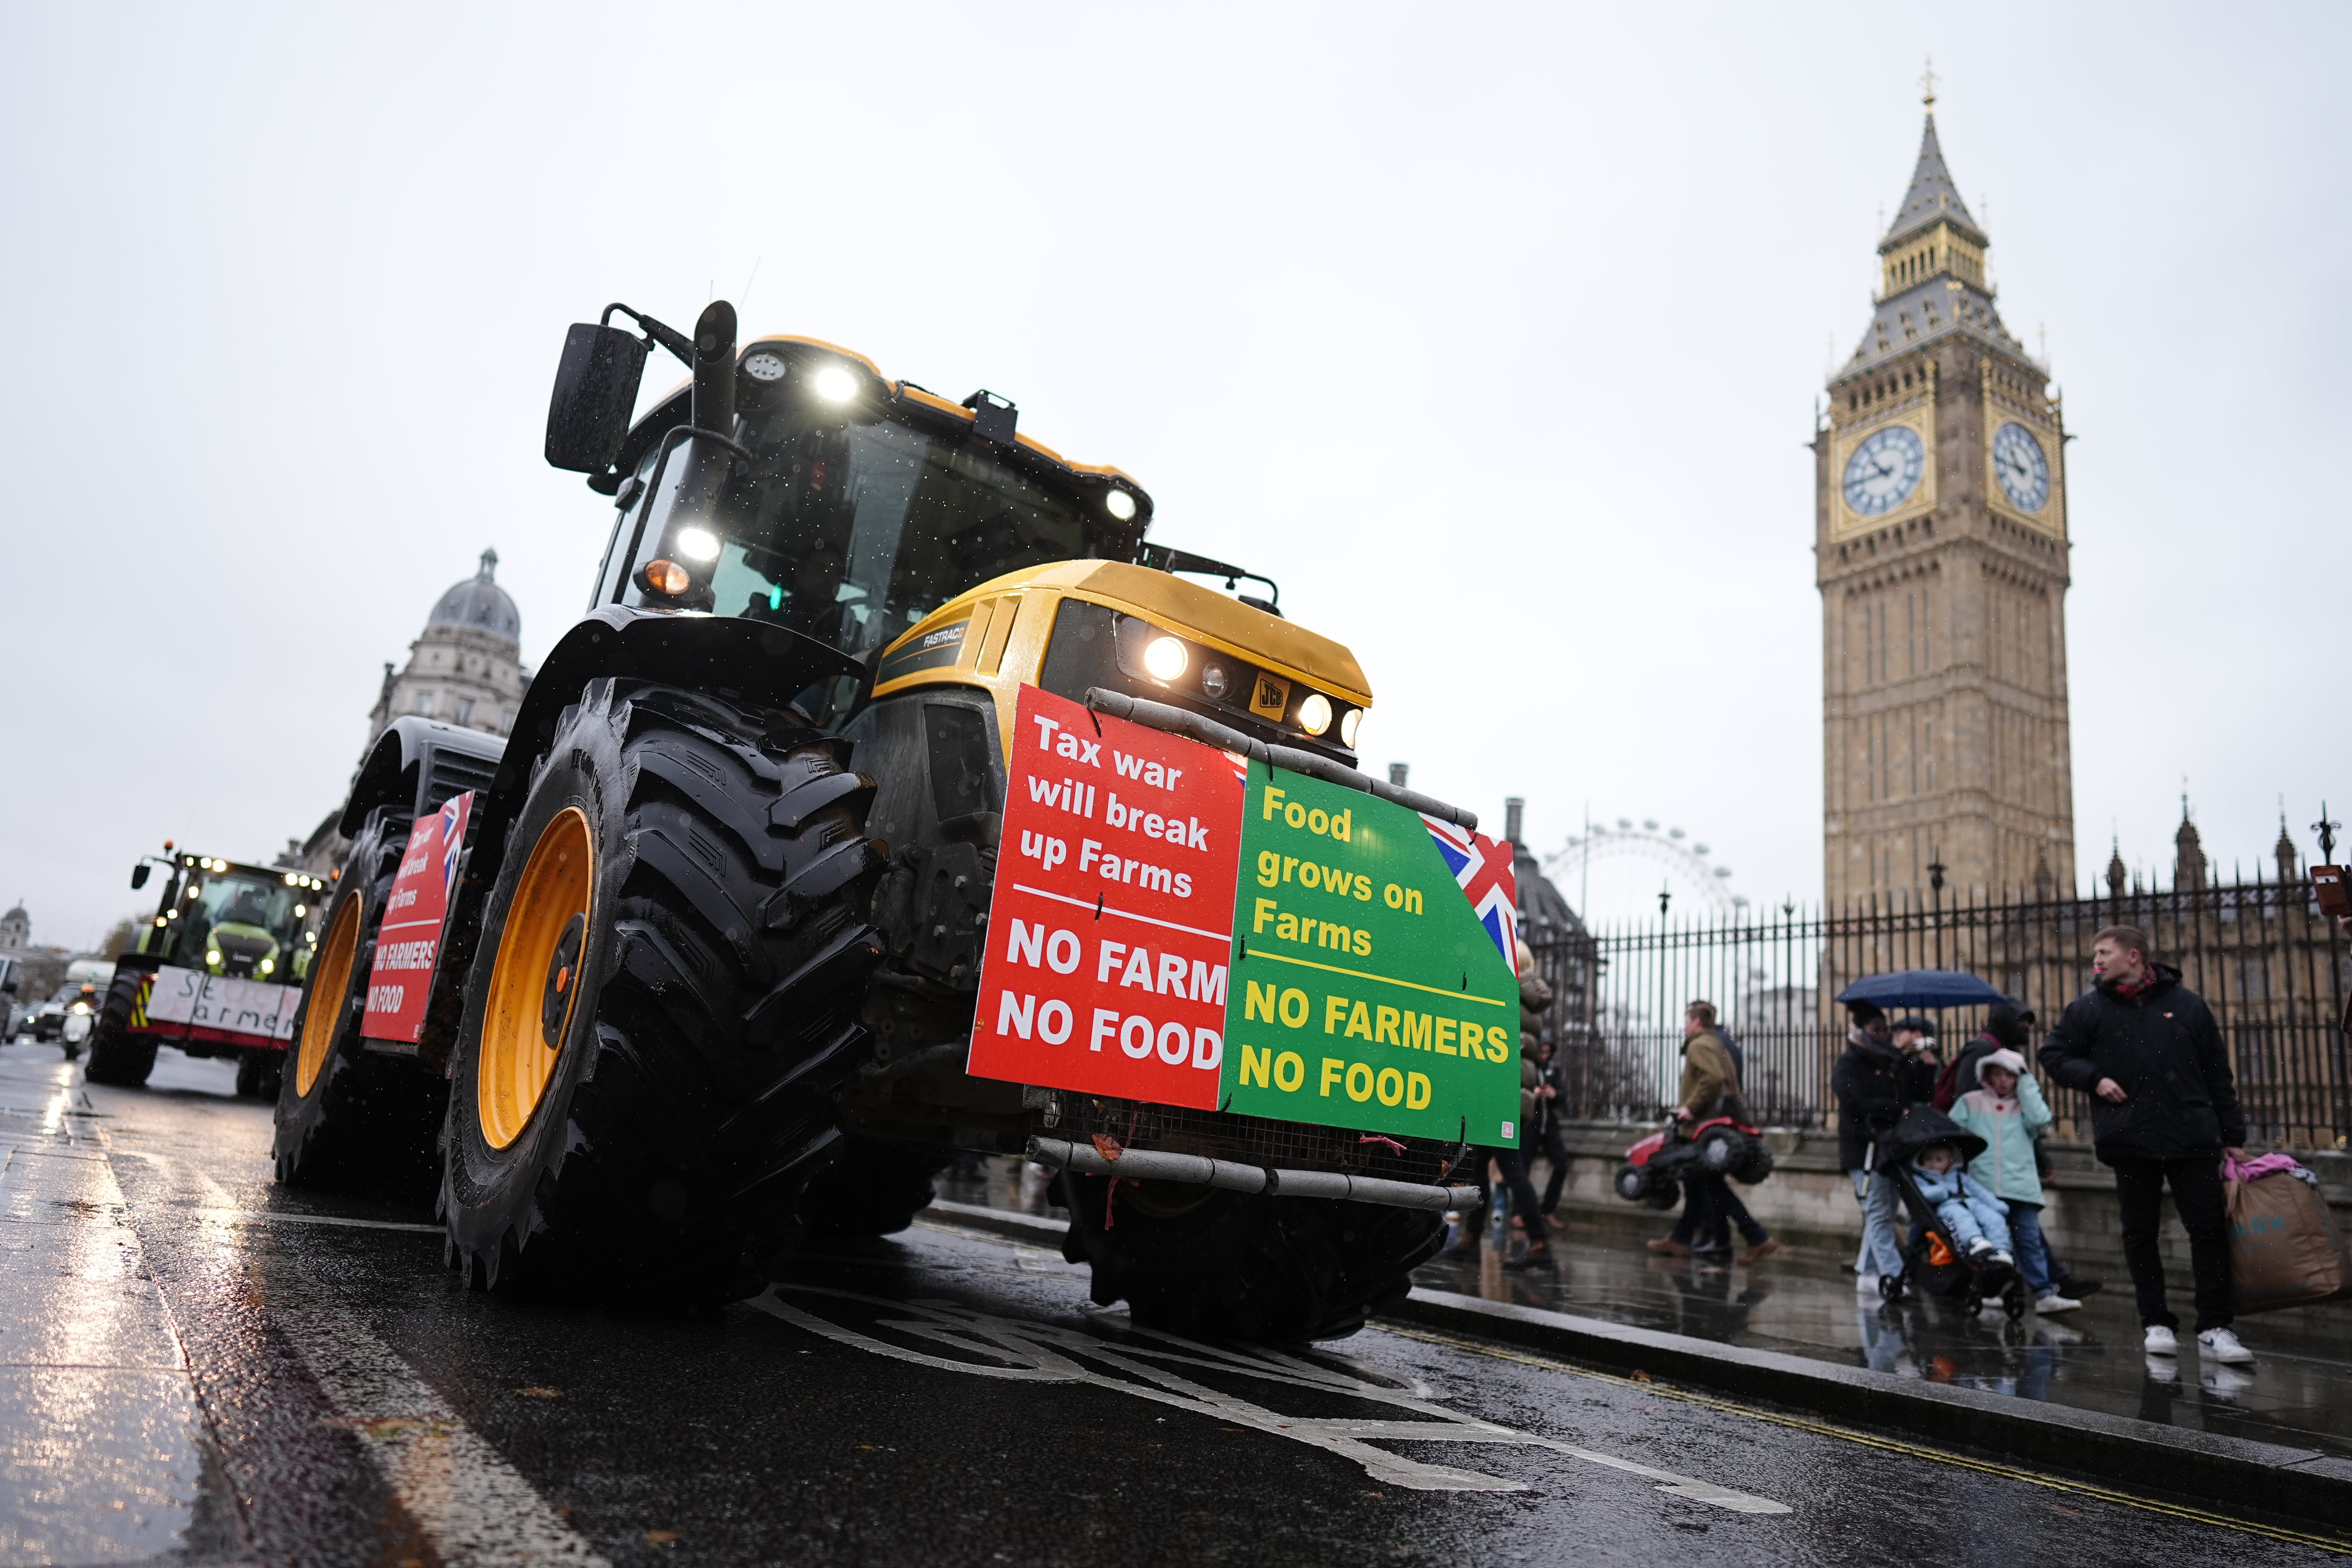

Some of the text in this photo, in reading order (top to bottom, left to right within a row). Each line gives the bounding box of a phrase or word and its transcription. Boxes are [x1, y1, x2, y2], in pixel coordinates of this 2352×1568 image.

[923, 628, 960, 647] FASTRAC
[1262, 683, 1281, 706] JCB
[1034, 714, 1182, 791] Tax war
[1028, 775, 1209, 852] will break
[1263, 786, 1351, 842] Food
[1021, 830, 1192, 897] up Farms
[1258, 851, 1422, 915] grows on
[394, 888, 418, 909] Farms
[1254, 898, 1371, 956] Farms
[374, 940, 436, 971] NO FARMERS
[1007, 918, 1227, 1005] NO FARM
[367, 985, 404, 1013] NO FOOD
[997, 990, 1222, 1070] NO FOOD
[1245, 980, 1508, 1063] NO FARMERS
[1240, 1045, 1431, 1109] NO FOOD
